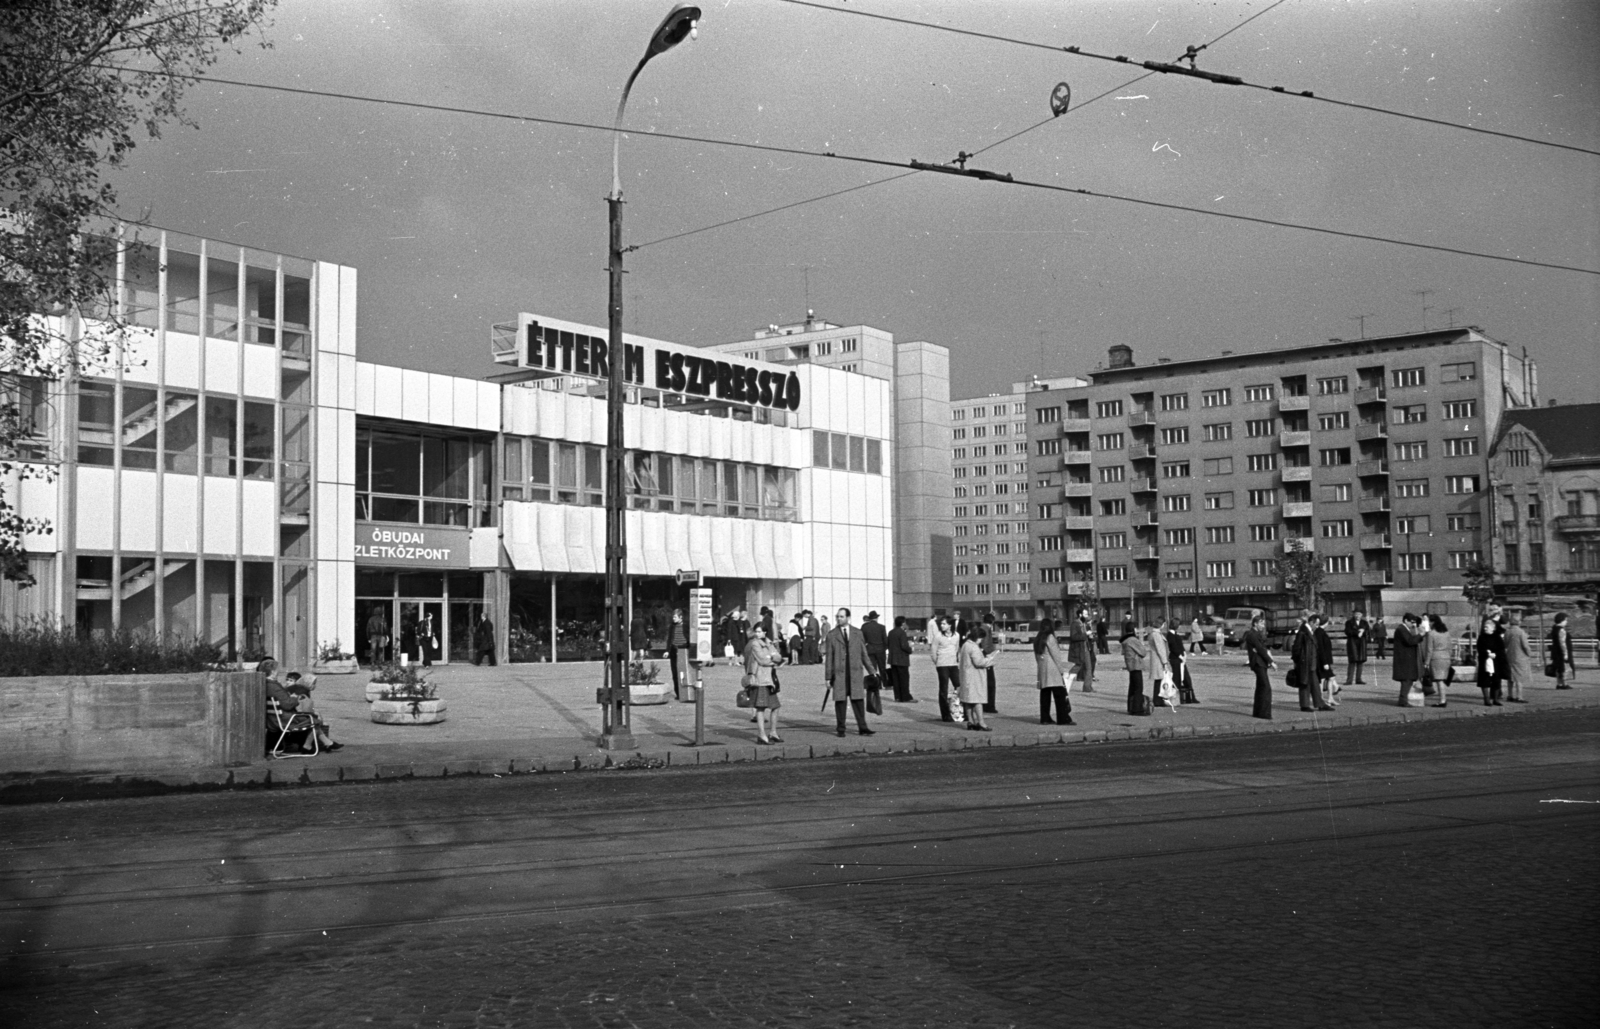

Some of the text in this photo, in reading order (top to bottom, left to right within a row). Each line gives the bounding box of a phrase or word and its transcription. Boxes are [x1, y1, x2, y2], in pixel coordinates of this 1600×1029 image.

[526, 320, 801, 412] ÉTTERM ESZPRESSZÓ
[355, 545, 451, 560] ZLETKÖZPONT
